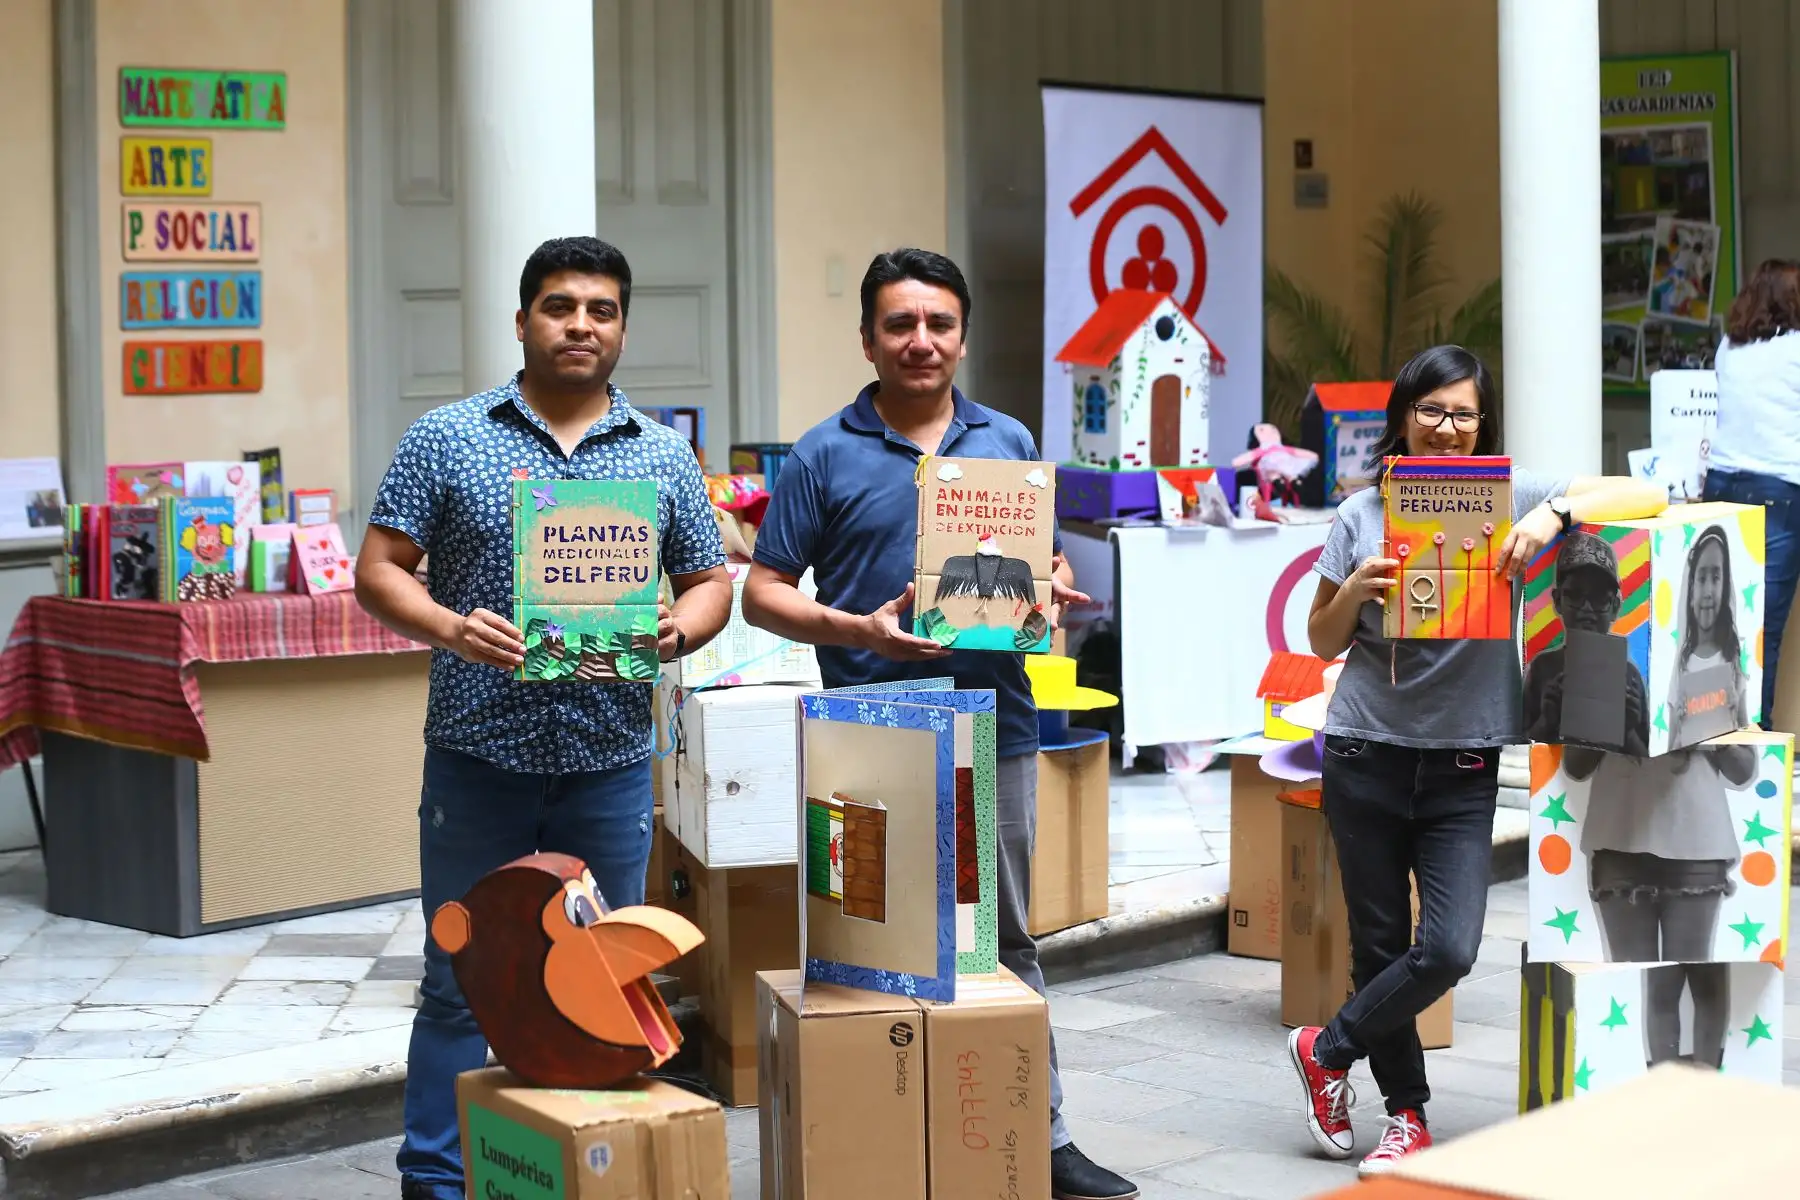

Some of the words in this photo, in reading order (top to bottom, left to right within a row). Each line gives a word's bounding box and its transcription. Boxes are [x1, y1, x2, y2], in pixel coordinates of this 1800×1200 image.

[130, 145, 207, 187] ARTE
[155, 210, 254, 252] SOCIAL
[131, 344, 260, 388] CIENCIA
[937, 487, 1036, 505] ANIMALES
[1400, 485, 1493, 497] INTELECTUALES
[936, 503, 958, 517] EN
[965, 505, 1036, 520] PELIGRO
[1400, 499, 1493, 513] PERUANAS
[543, 525, 649, 543] PLANTAS
[936, 522, 953, 533] DE
[958, 522, 1035, 537] EXTINCION
[543, 548, 649, 559] MEDICINALES
[889, 1022, 914, 1047] hp
[895, 1051, 908, 1096] Desktop
[480, 1136, 554, 1191] Lumpérica
